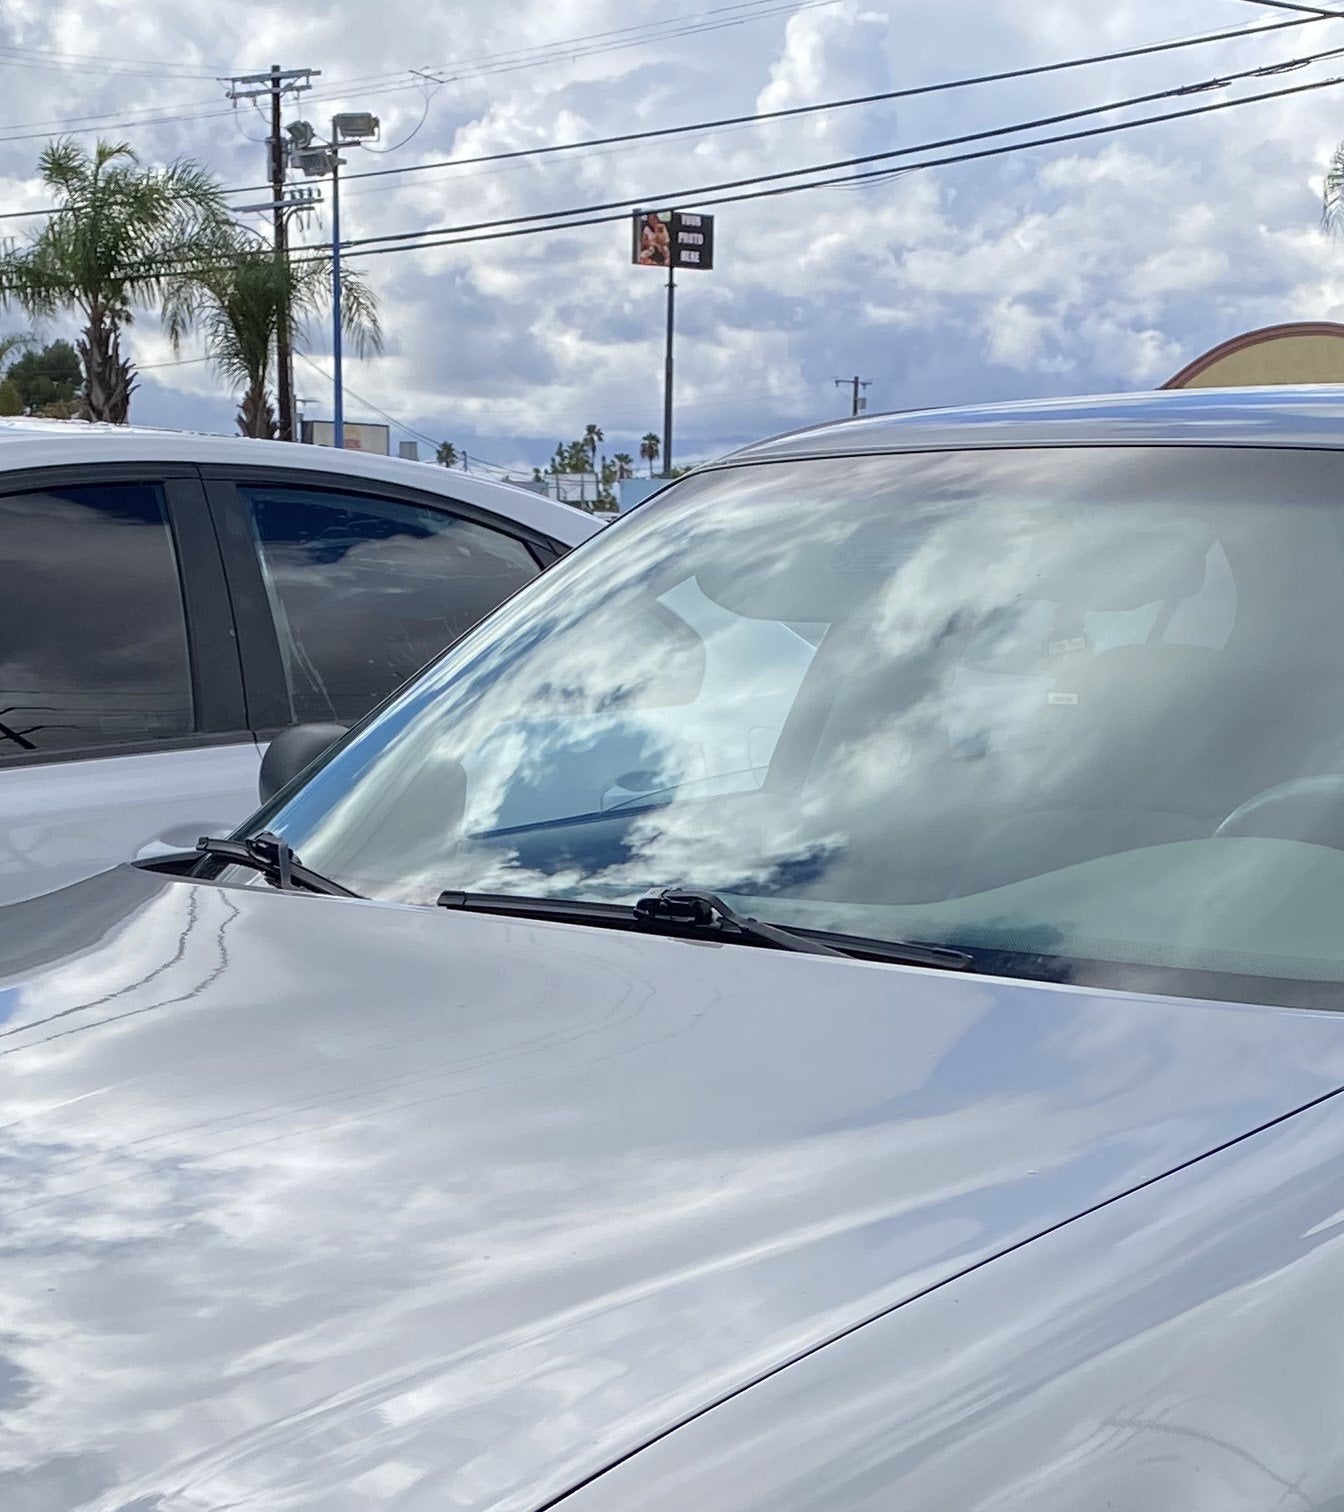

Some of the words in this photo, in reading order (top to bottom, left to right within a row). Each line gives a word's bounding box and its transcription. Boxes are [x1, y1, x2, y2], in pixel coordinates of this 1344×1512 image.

[681, 215, 701, 227] YOUR
[677, 231, 704, 245] PHOTO
[679, 250, 700, 263] HERE
